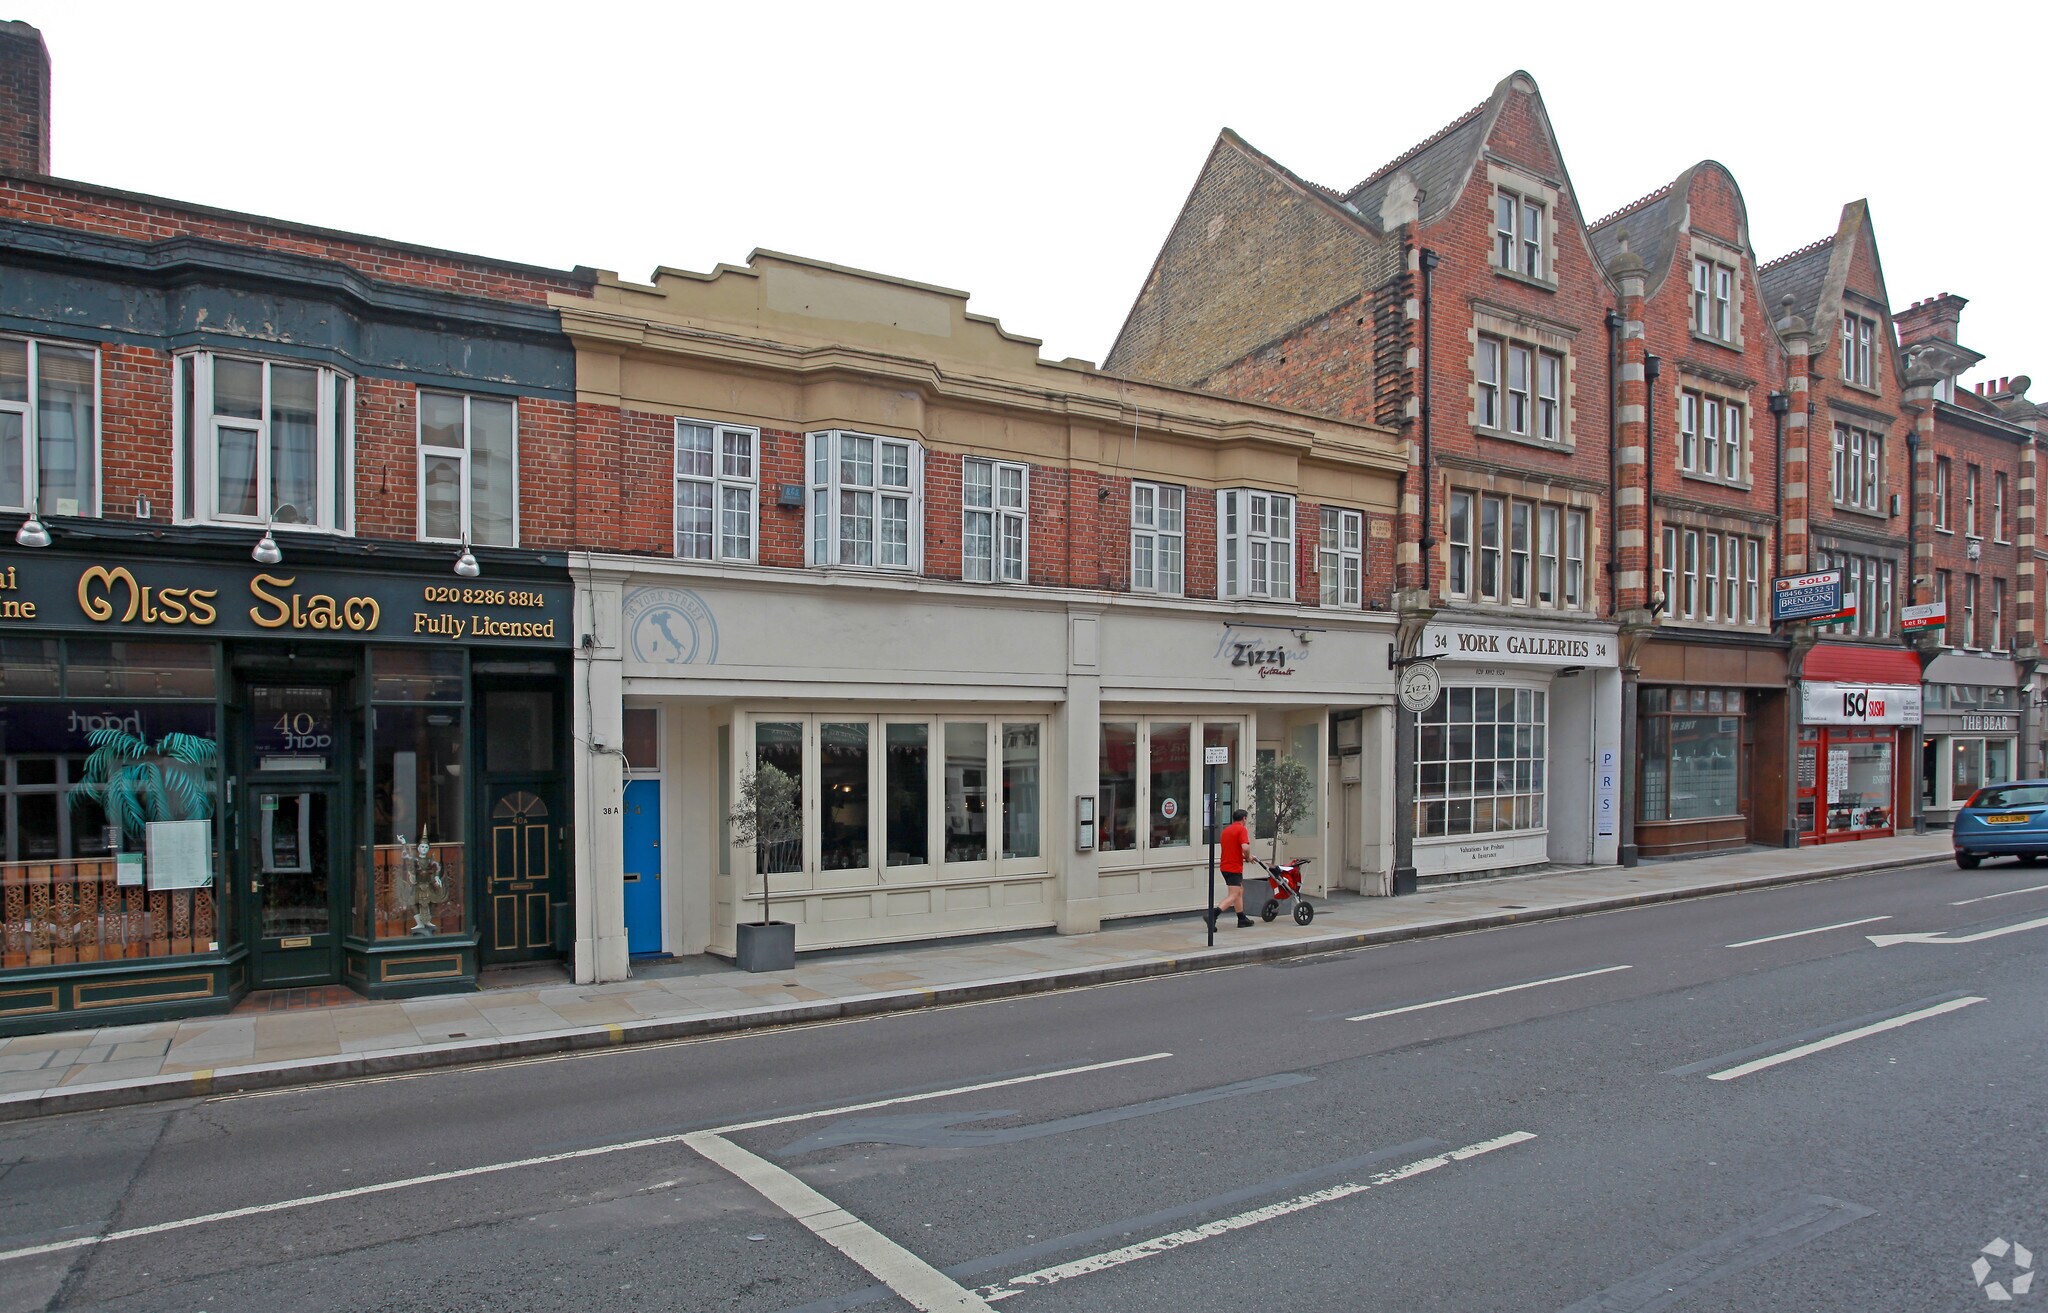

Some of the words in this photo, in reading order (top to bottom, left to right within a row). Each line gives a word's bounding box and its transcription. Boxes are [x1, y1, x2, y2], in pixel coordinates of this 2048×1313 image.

[1798, 576, 1831, 586] SOLD
[424, 586, 460, 603] 020
[463, 587, 505, 605] 8286
[508, 591, 544, 608] 8814
[1780, 590, 1803, 598] 08456
[1826, 584, 1834, 592] 51
[625, 606, 638, 620] 36
[636, 591, 664, 608] YORK
[668, 592, 705, 621] STREET
[1781, 593, 1832, 608] BRENDONS
[414, 612, 467, 639] Fully
[471, 615, 555, 639] Licensed
[1434, 635, 1448, 648] 34
[1457, 633, 1499, 653] YORK
[1506, 636, 1589, 657] GALLERIES
[1595, 644, 1606, 656] 34
[1231, 643, 1286, 667] Zizzi
[1405, 682, 1431, 694] Zizzi
[1868, 700, 1885, 717] SUSHI
[273, 712, 314, 735] 40
[1962, 715, 1982, 730] THE
[1983, 716, 2008, 730] BEAR
[1604, 753, 1612, 764] P
[1603, 776, 1611, 787] R
[603, 807, 612, 815] 38
[613, 807, 619, 815] A
[1602, 799, 1610, 810] S
